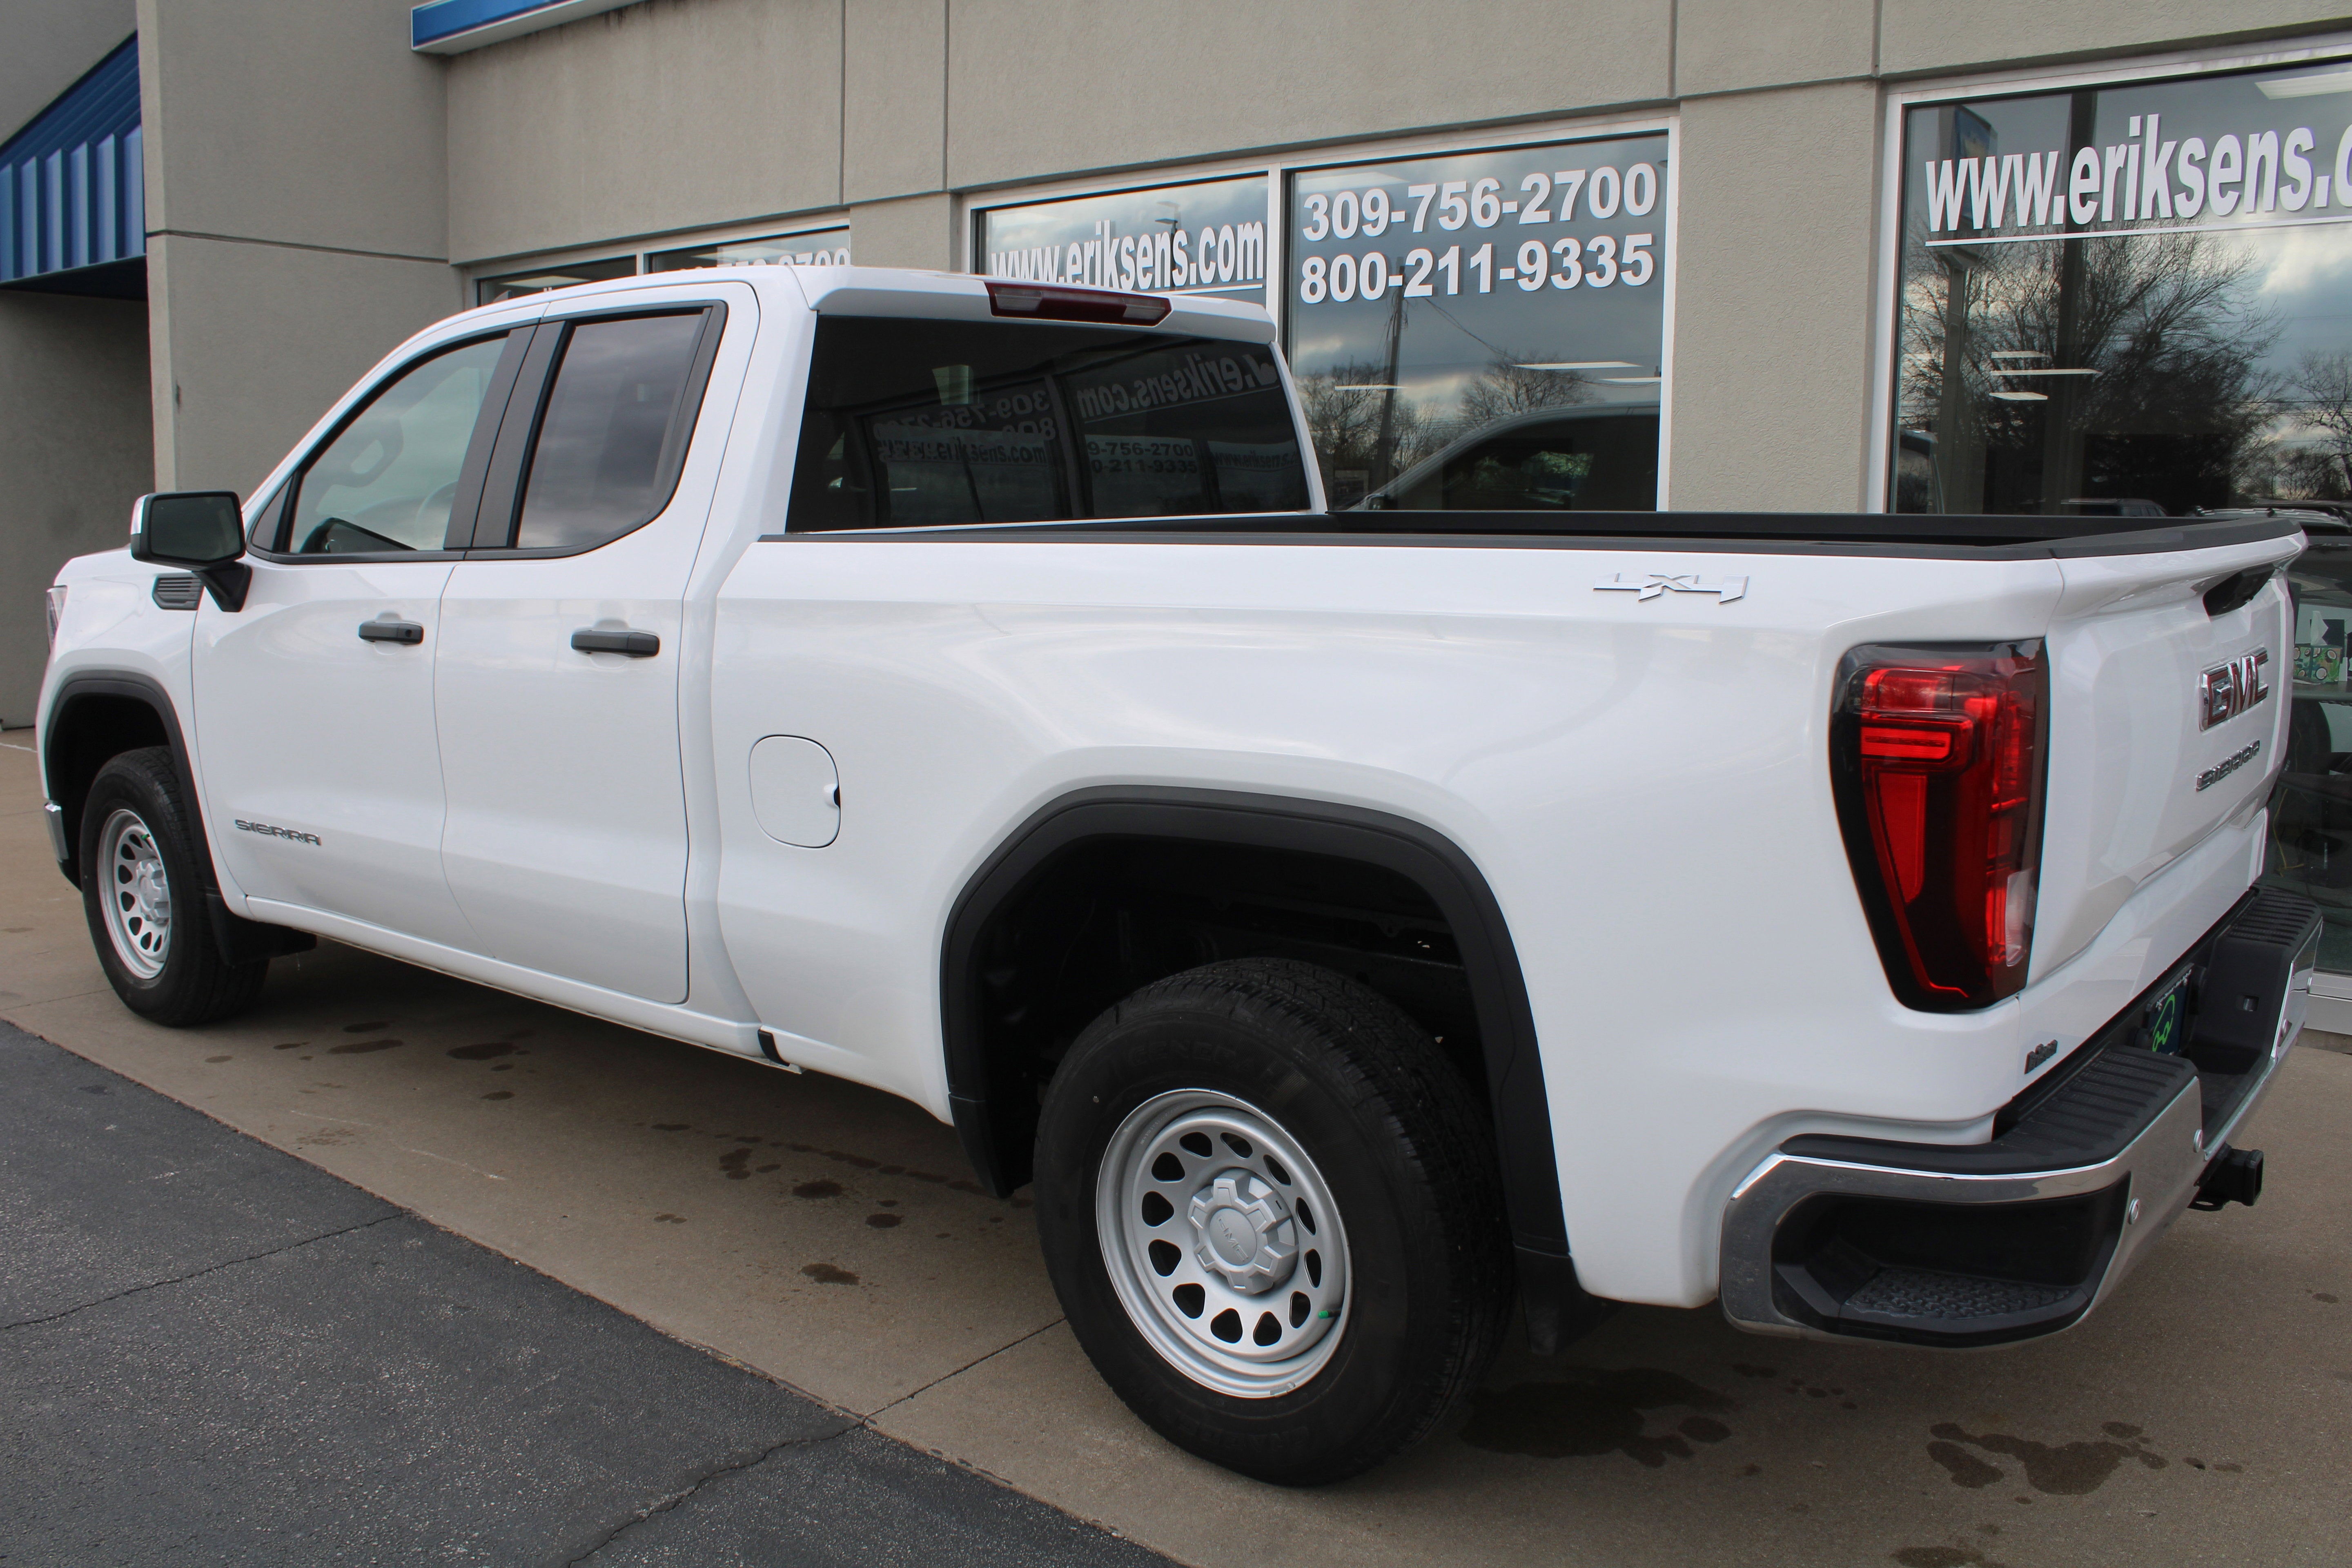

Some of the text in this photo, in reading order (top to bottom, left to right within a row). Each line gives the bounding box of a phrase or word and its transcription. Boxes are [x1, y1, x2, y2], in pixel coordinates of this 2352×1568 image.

[1303, 163, 1656, 241] 309-756-2700
[991, 220, 1264, 291] wweriksens.com
[1300, 234, 1653, 304] 800-211-9335
[2200, 646, 2269, 731] GMC
[235, 819, 322, 846] SIERRA
[1217, 1216, 1249, 1262] GMC
